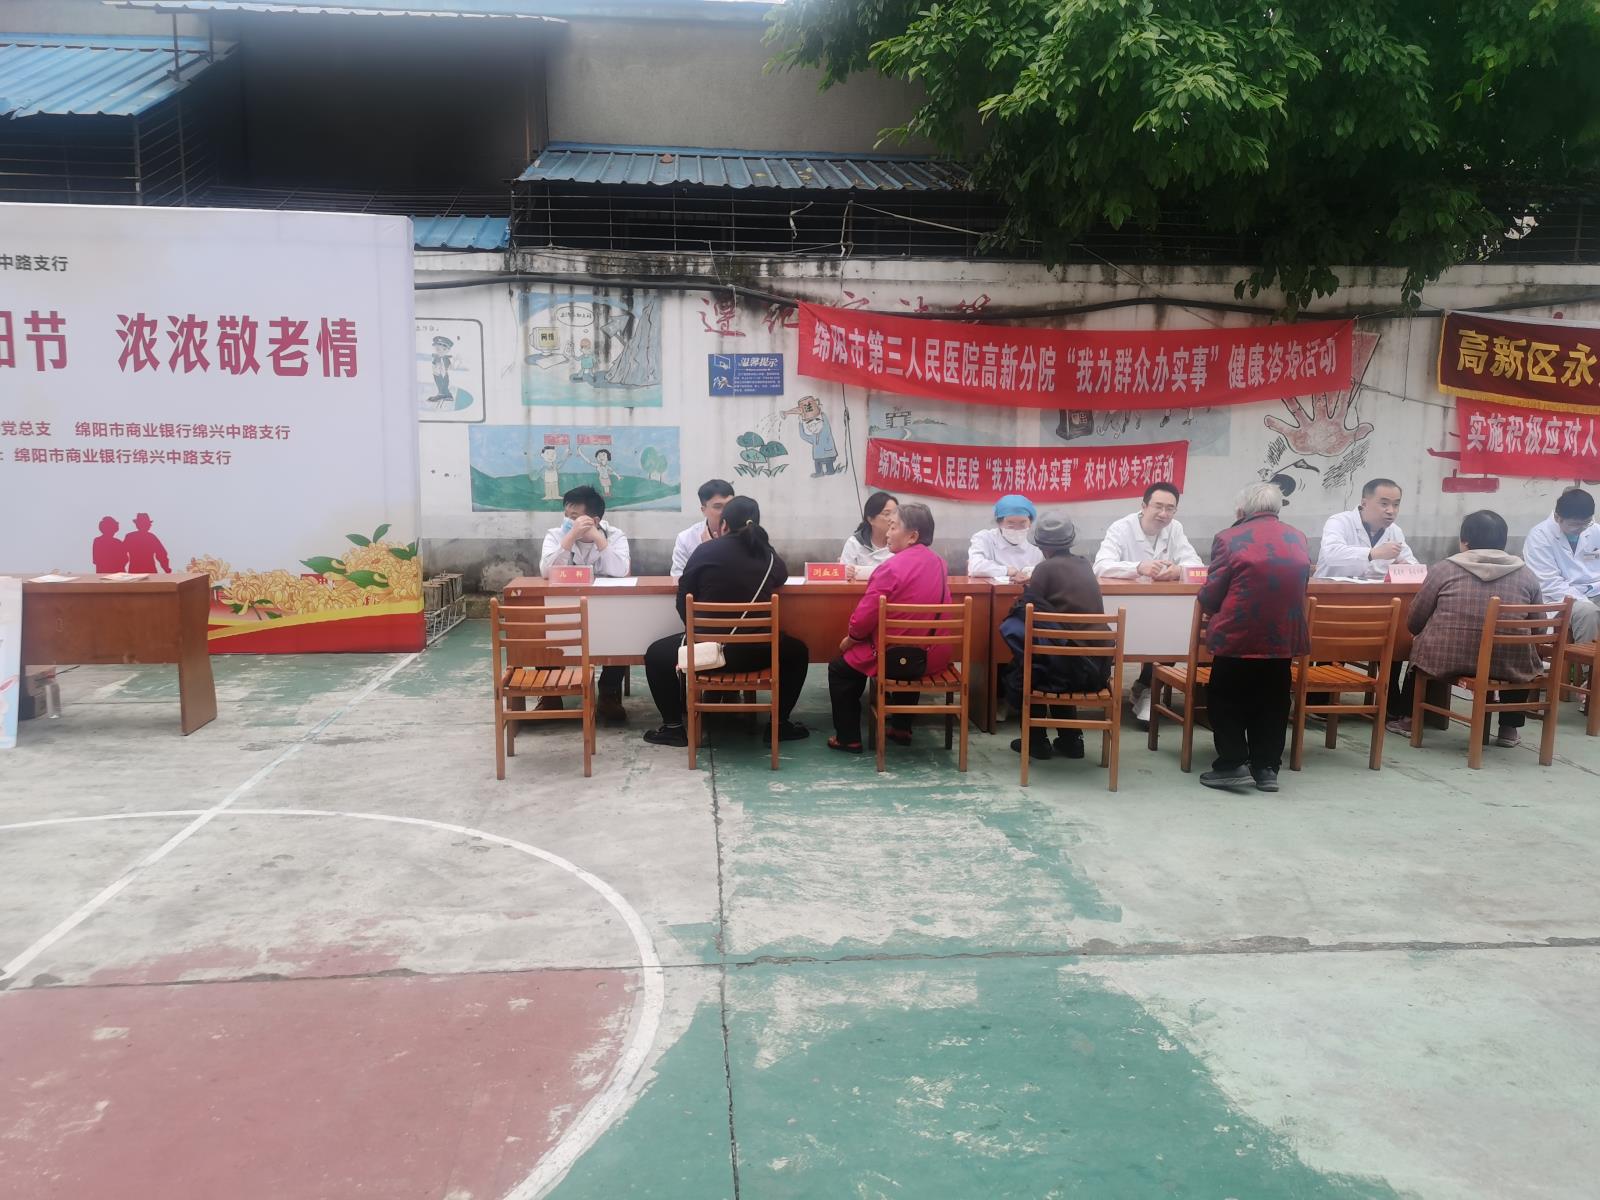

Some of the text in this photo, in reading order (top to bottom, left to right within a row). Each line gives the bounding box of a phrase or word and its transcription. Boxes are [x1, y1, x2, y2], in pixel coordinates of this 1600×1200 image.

[0, 253, 68, 272] 中路支行
[116, 312, 359, 378] 浓浓敬老情
[1456, 329, 1598, 388] 高新区永
[74, 421, 291, 440] 绵阳市商业银行绵兴中路支行
[1466, 411, 1598, 457] 实施积极应对人
